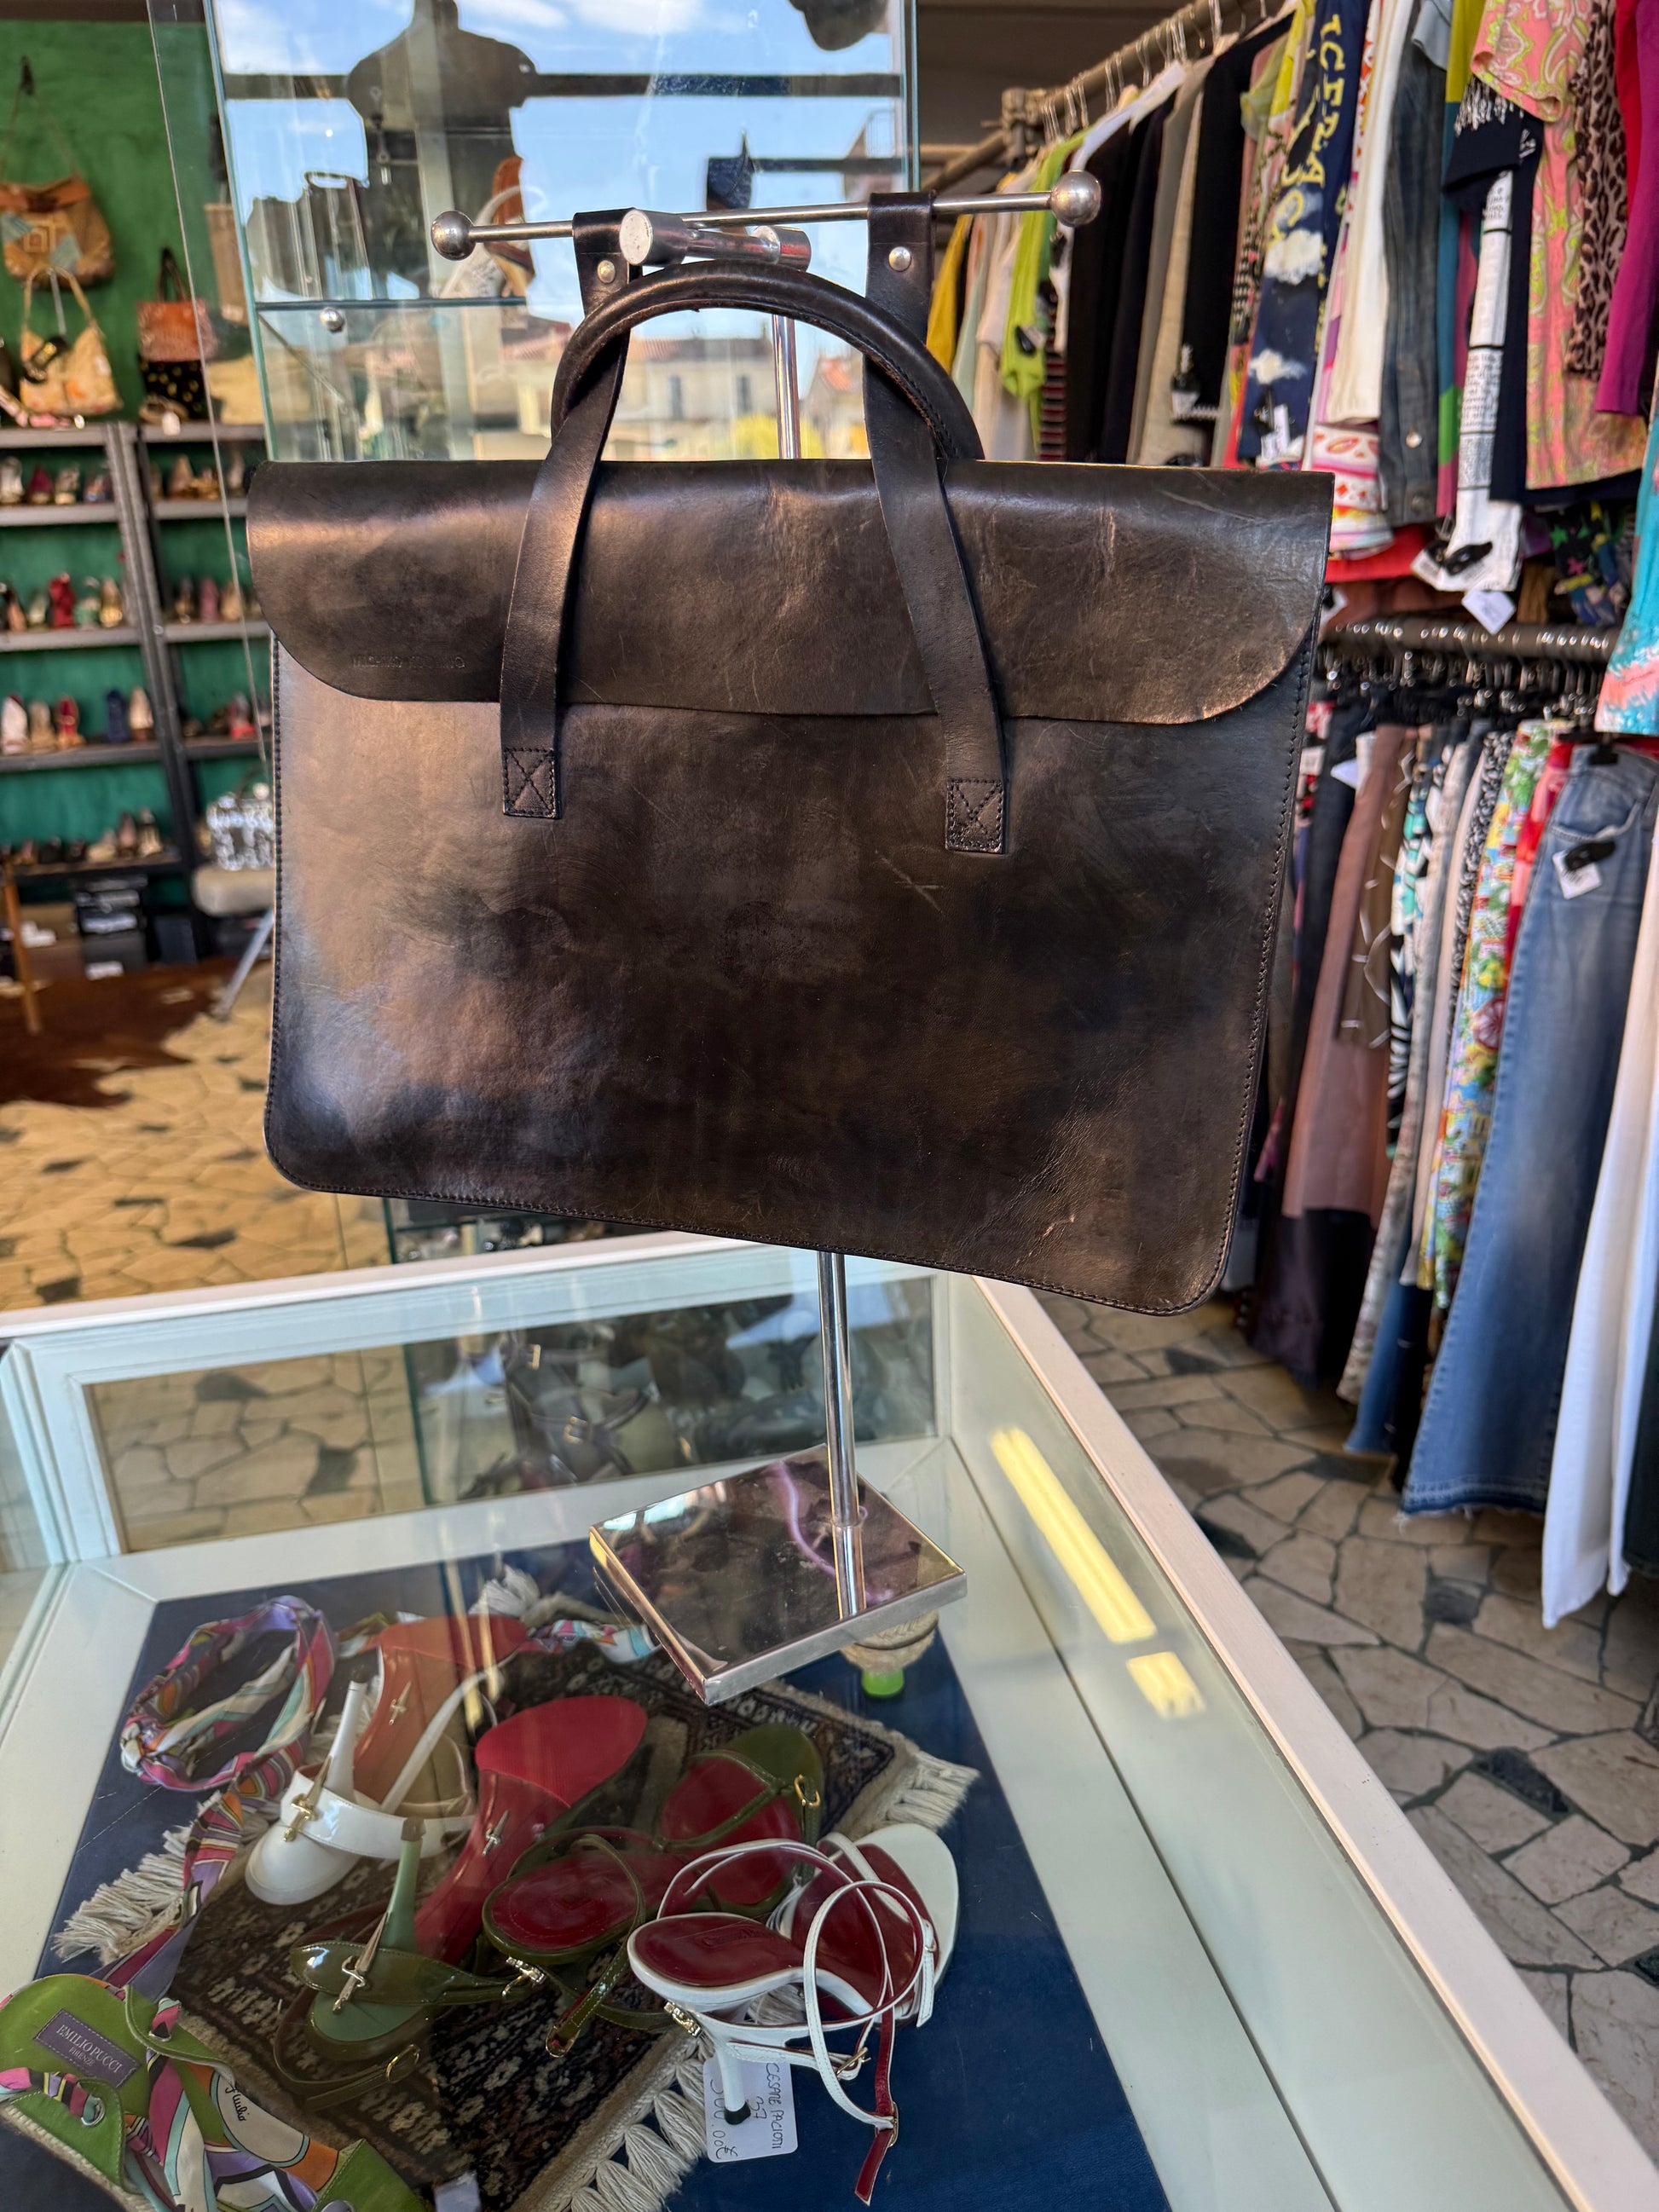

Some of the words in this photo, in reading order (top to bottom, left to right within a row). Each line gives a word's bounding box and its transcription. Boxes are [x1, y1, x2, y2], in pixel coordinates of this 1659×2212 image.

[56, 2024, 94, 2052] EMILIO
[90, 2047, 123, 2073] PUCCI
[68, 2047, 95, 2067] FIRENZE
[747, 2096, 766, 2119] 37
